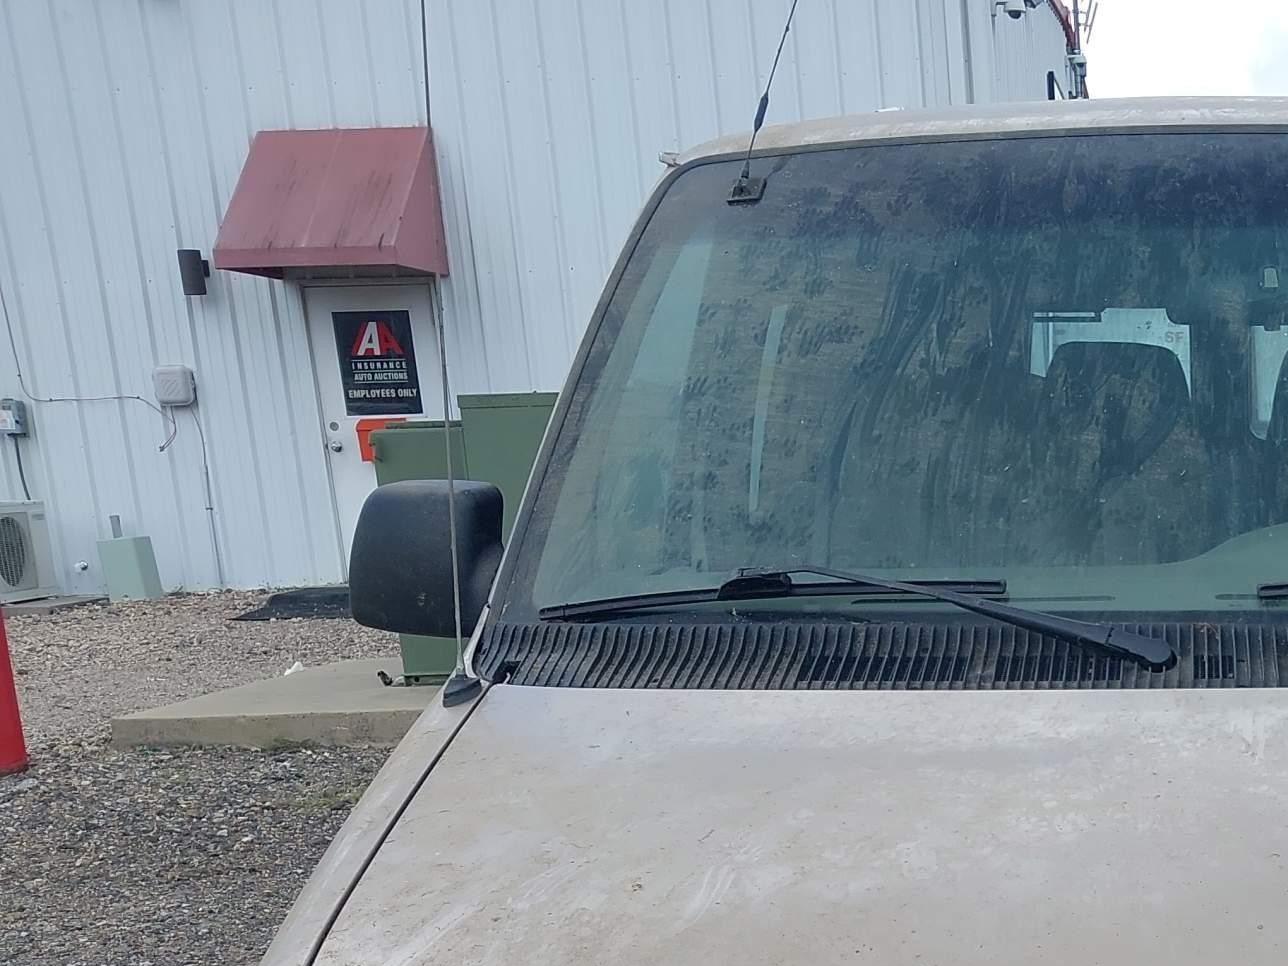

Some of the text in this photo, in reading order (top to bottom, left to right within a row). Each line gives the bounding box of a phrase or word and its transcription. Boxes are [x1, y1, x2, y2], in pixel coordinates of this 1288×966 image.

[351, 361, 407, 370] INSURANCE
[354, 372, 408, 381] AUTO AUCTIONS
[348, 388, 418, 398] EMPLOYEES ONLY
